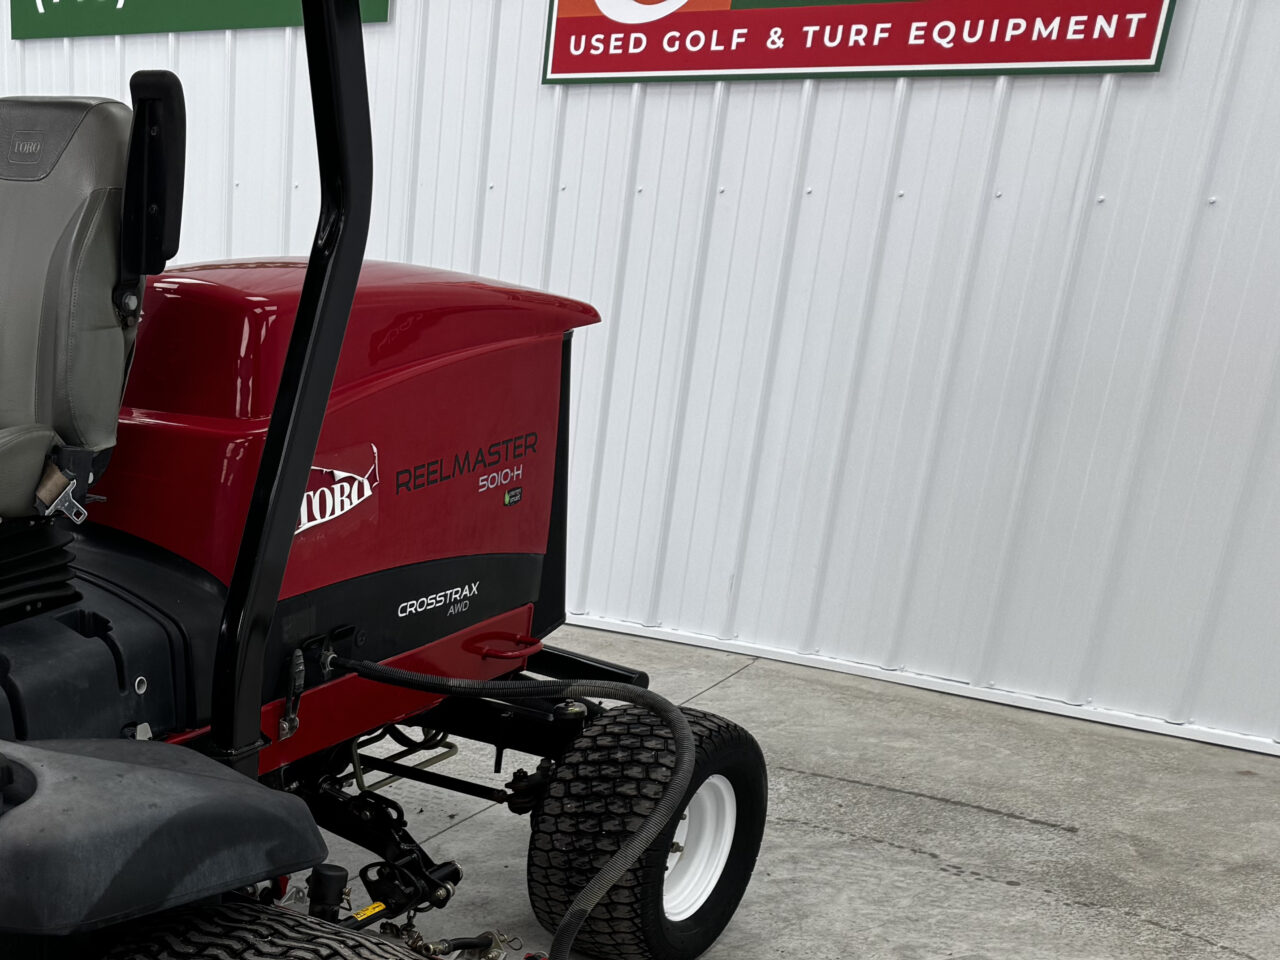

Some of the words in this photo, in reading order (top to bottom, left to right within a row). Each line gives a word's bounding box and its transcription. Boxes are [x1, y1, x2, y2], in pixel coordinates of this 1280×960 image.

[570, 33, 648, 56] USED
[662, 28, 748, 53] GOLF
[766, 27, 785, 49] &
[802, 22, 892, 48] TURF
[908, 13, 1147, 48] EQUIPMENT
[14, 141, 41, 153] TORO
[395, 432, 538, 495] REELMASTER
[397, 581, 480, 617] CROSSTRAX
[447, 600, 470, 617] AWD
